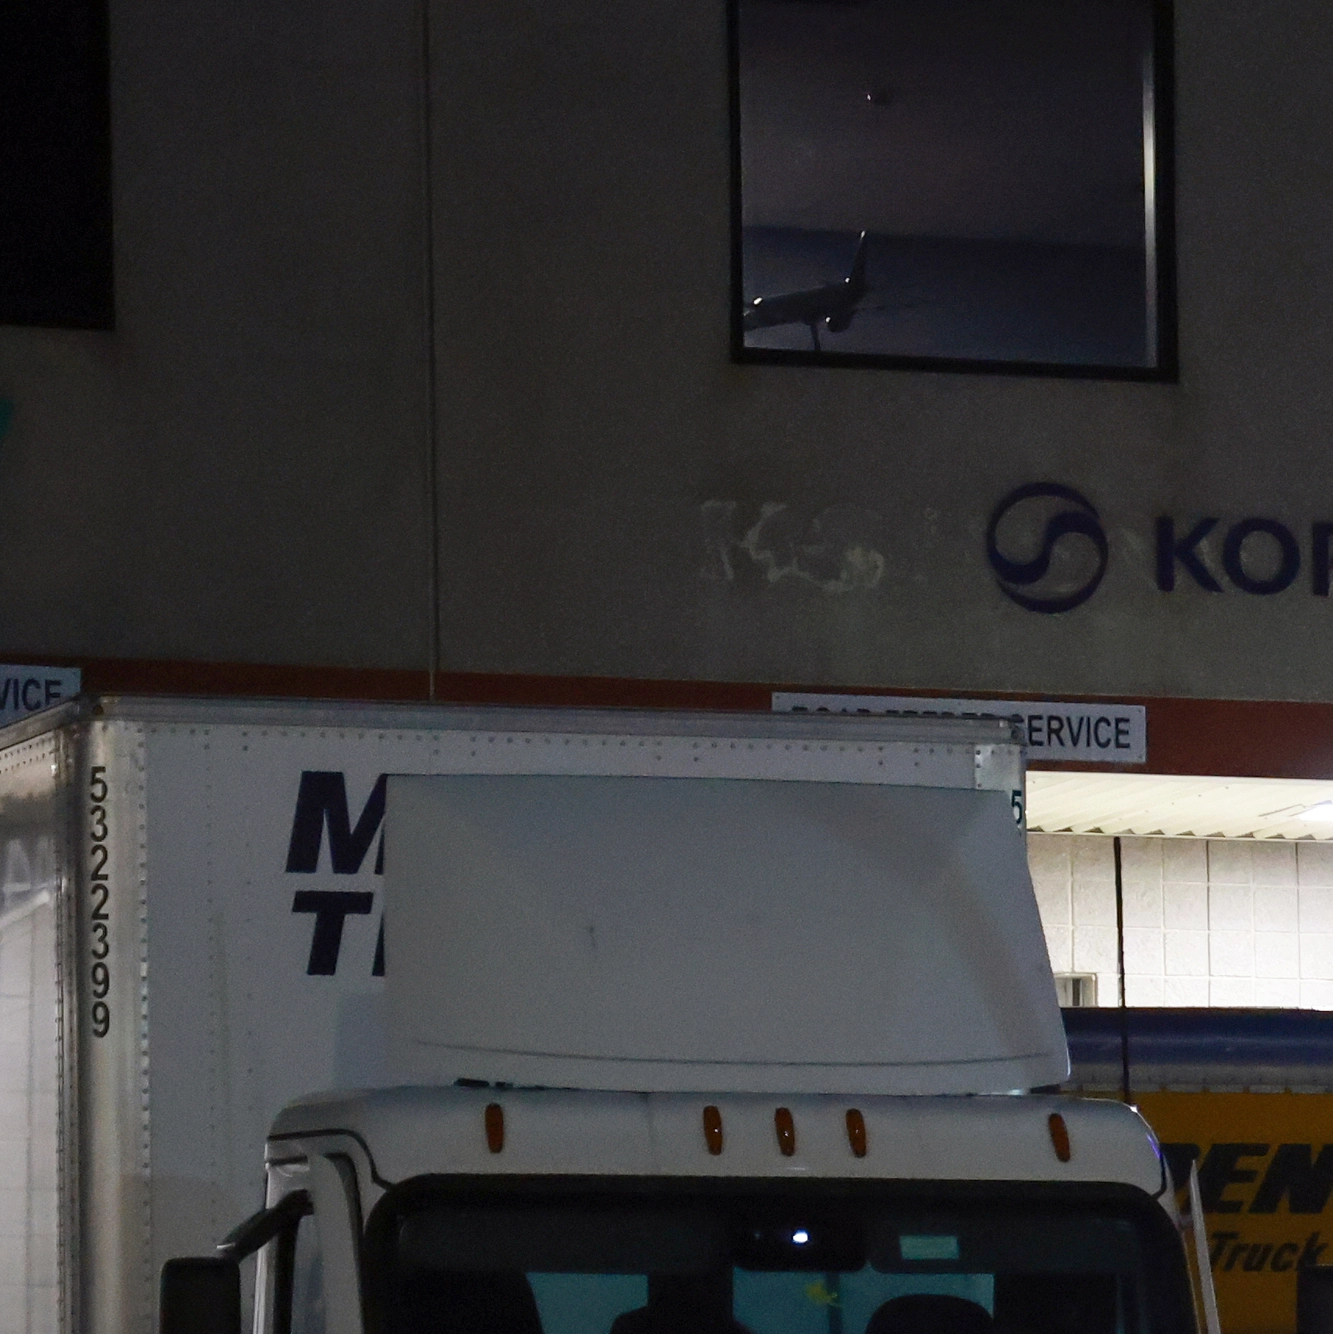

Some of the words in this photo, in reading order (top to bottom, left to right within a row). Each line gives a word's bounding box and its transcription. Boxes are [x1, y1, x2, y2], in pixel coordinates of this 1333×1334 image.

[1009, 713, 1130, 749] ERVICE
[90, 766, 110, 1038] 5322399
[1208, 1231, 1328, 1273] Truck
